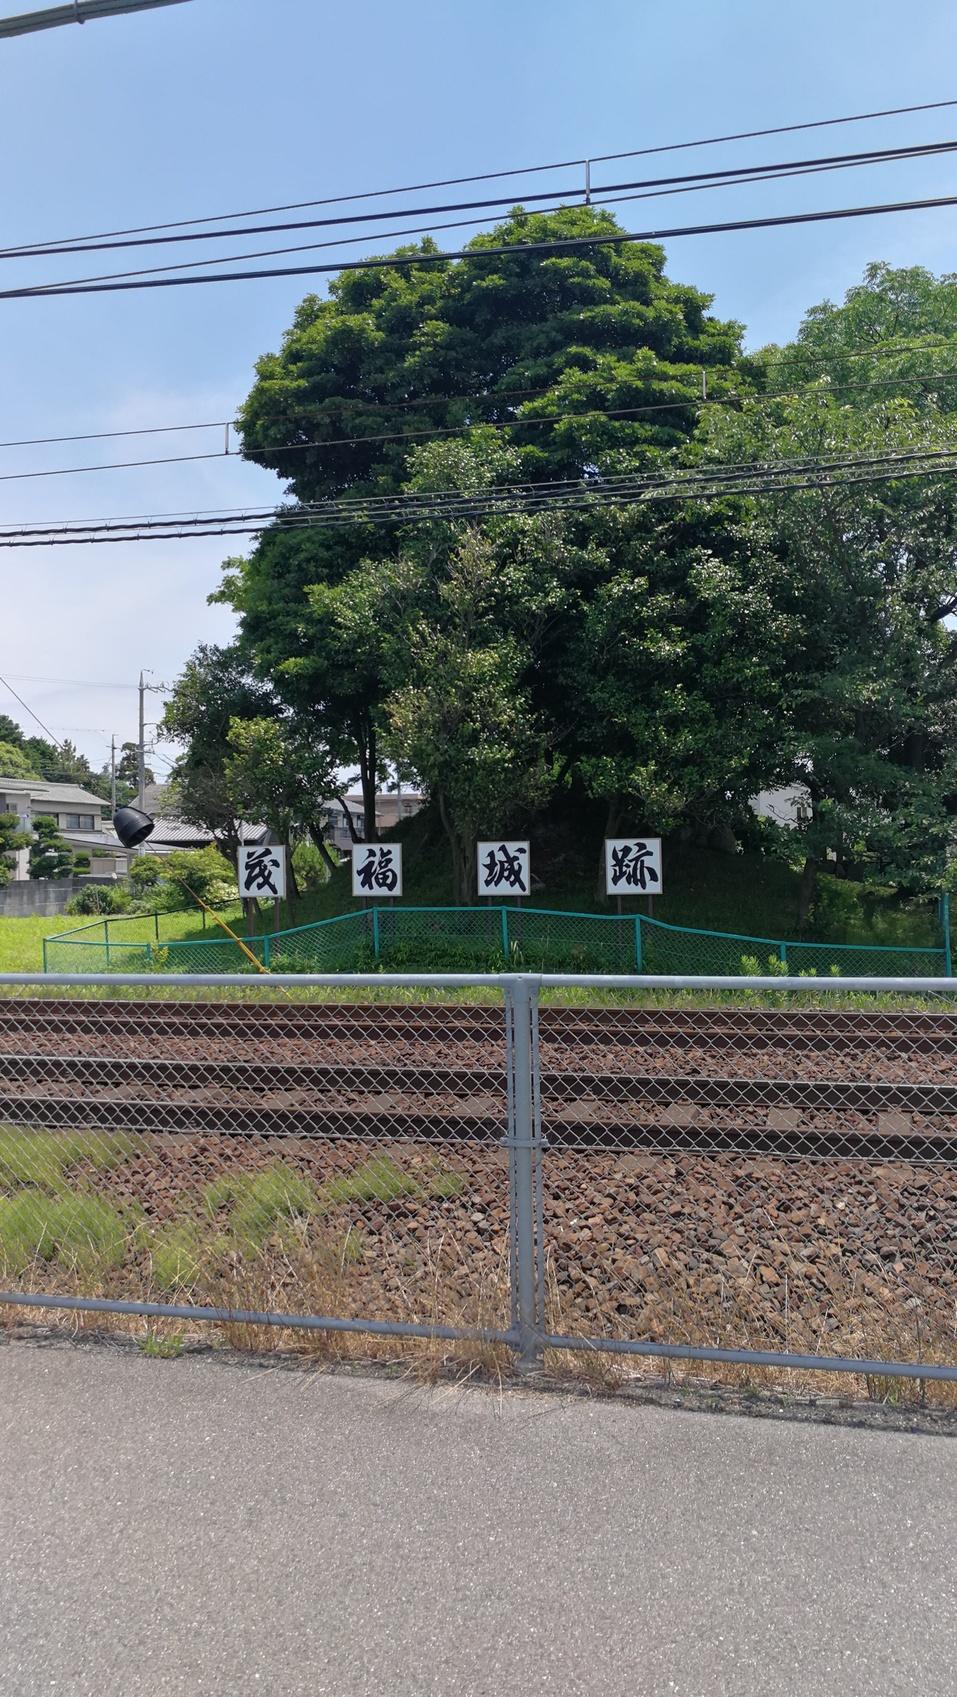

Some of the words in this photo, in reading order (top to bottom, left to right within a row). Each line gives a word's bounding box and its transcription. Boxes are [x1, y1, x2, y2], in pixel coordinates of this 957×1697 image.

[244, 847, 280, 895] 茂
[356, 847, 398, 892] 福
[483, 844, 527, 892] 城
[611, 842, 658, 890] 跡
